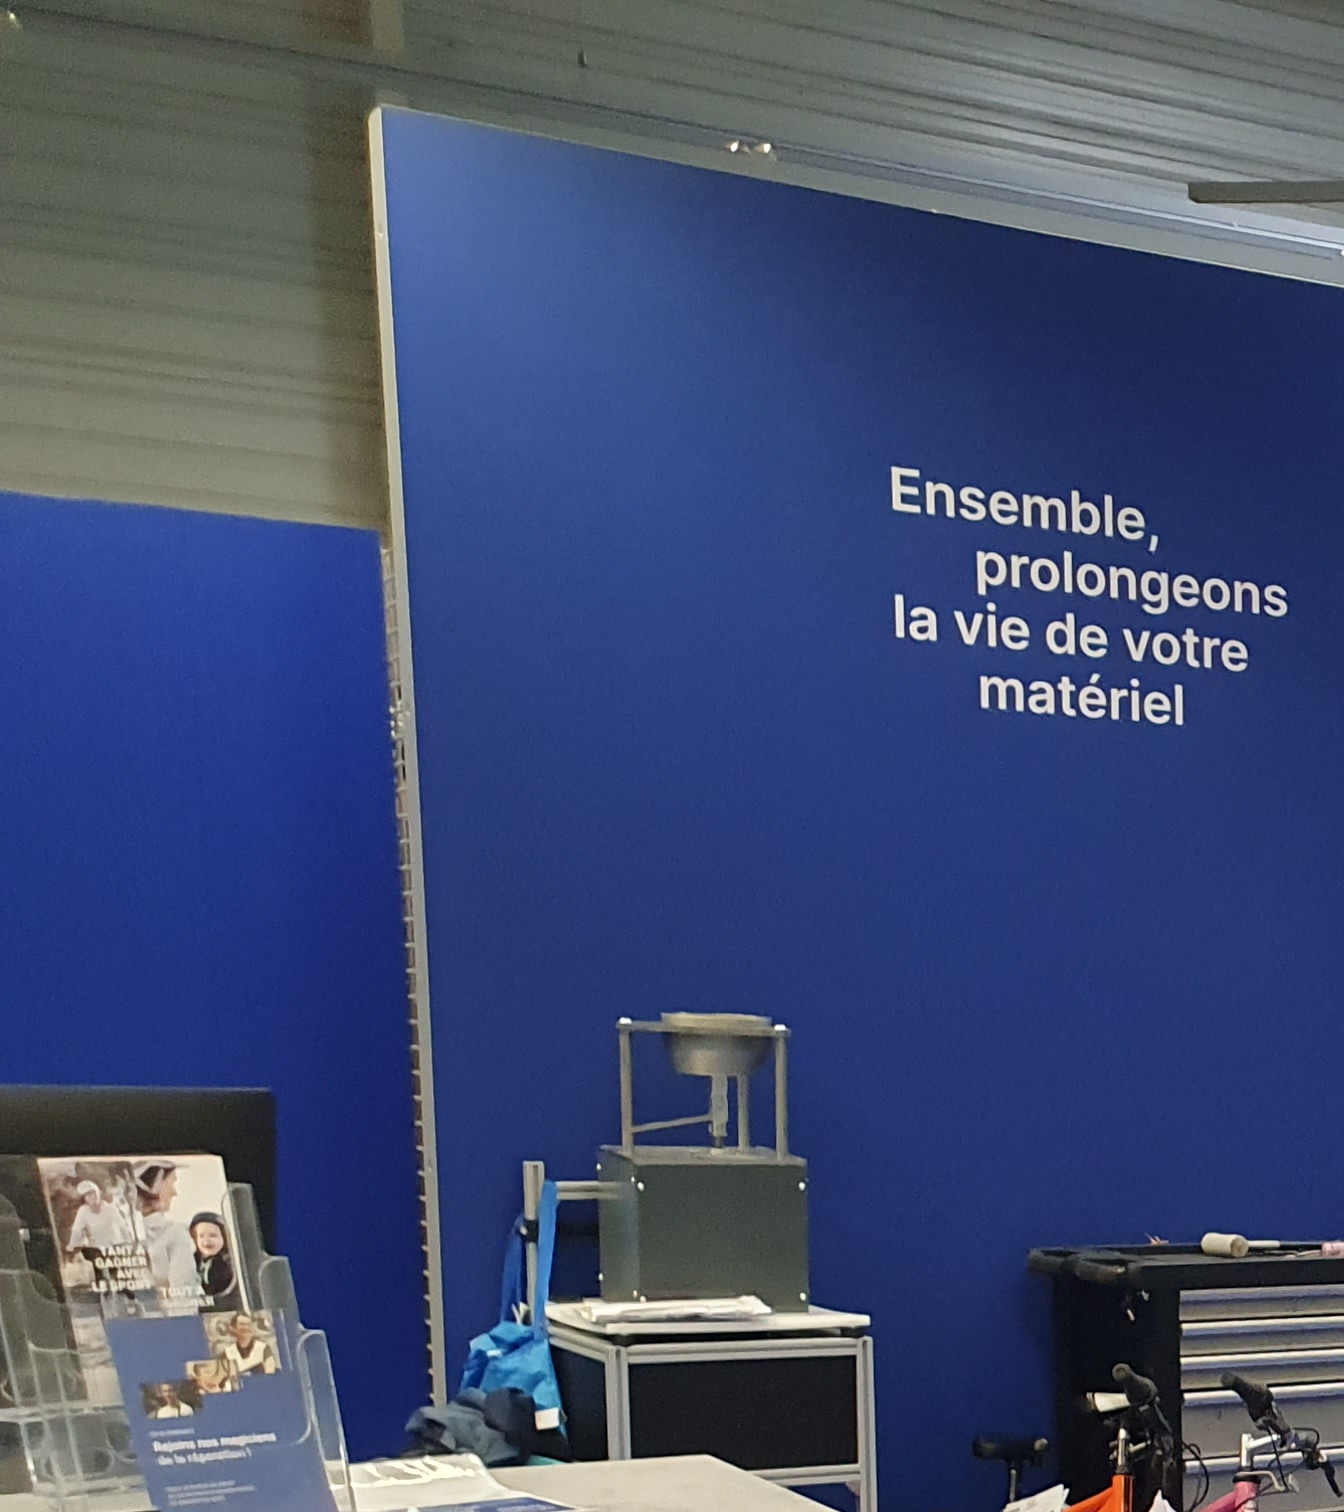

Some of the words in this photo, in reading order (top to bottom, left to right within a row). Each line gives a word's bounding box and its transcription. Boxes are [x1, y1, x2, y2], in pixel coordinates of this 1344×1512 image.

[891, 466, 1159, 552] Ensemble,
[976, 550, 1288, 618] prolongeons
[894, 594, 938, 641] la
[954, 602, 1030, 651] vie
[1046, 612, 1108, 657] de
[1123, 627, 1249, 672] votre
[979, 673, 1185, 726] matériel
